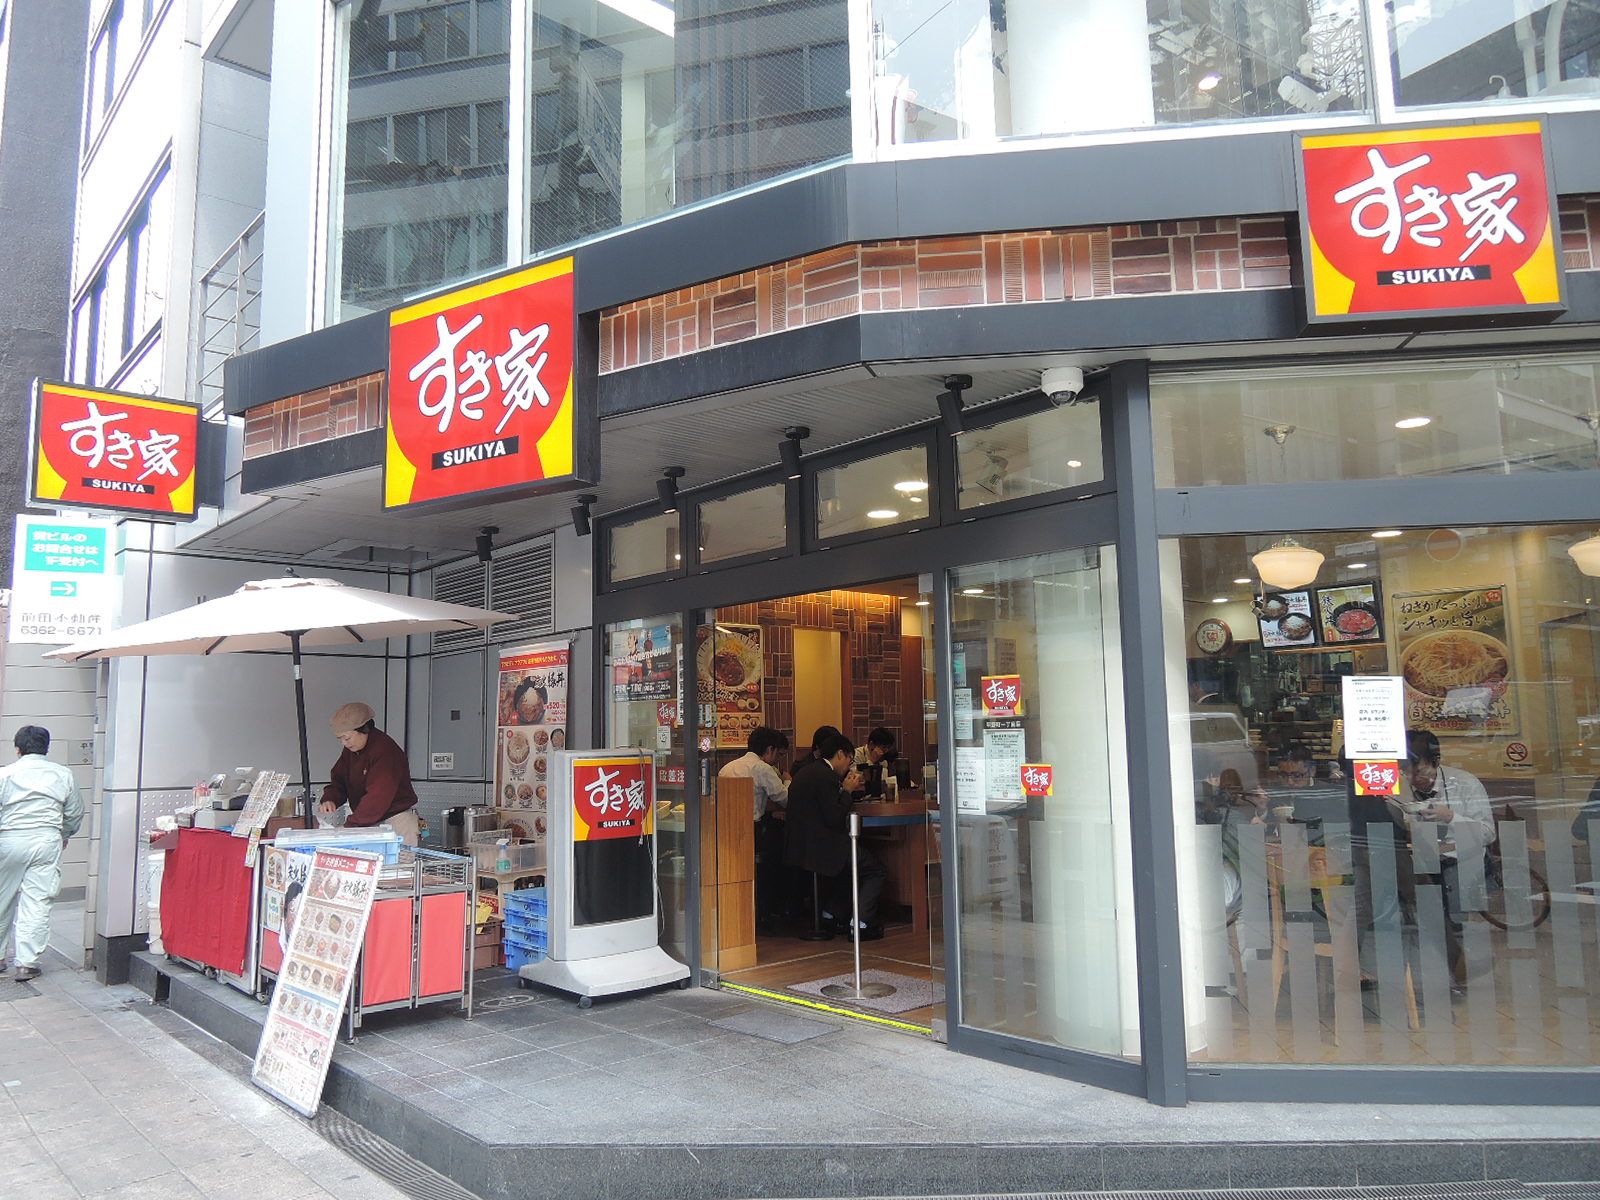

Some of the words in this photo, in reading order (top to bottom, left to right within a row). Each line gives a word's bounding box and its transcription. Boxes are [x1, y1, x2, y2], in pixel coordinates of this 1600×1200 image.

[1334, 148, 1526, 262] すき家
[1392, 266, 1476, 285] SUKIYA
[408, 314, 550, 435] すき家
[60, 401, 180, 481] すき家
[442, 440, 507, 467] SUKIYA
[92, 479, 146, 493] SUKIYA
[986, 679, 1017, 705] すき家
[659, 702, 677, 720] すき家
[1024, 767, 1049, 789] すき家
[1359, 763, 1395, 785] すき家
[584, 767, 645, 817] すき家
[603, 819, 631, 828] SUKIYA
